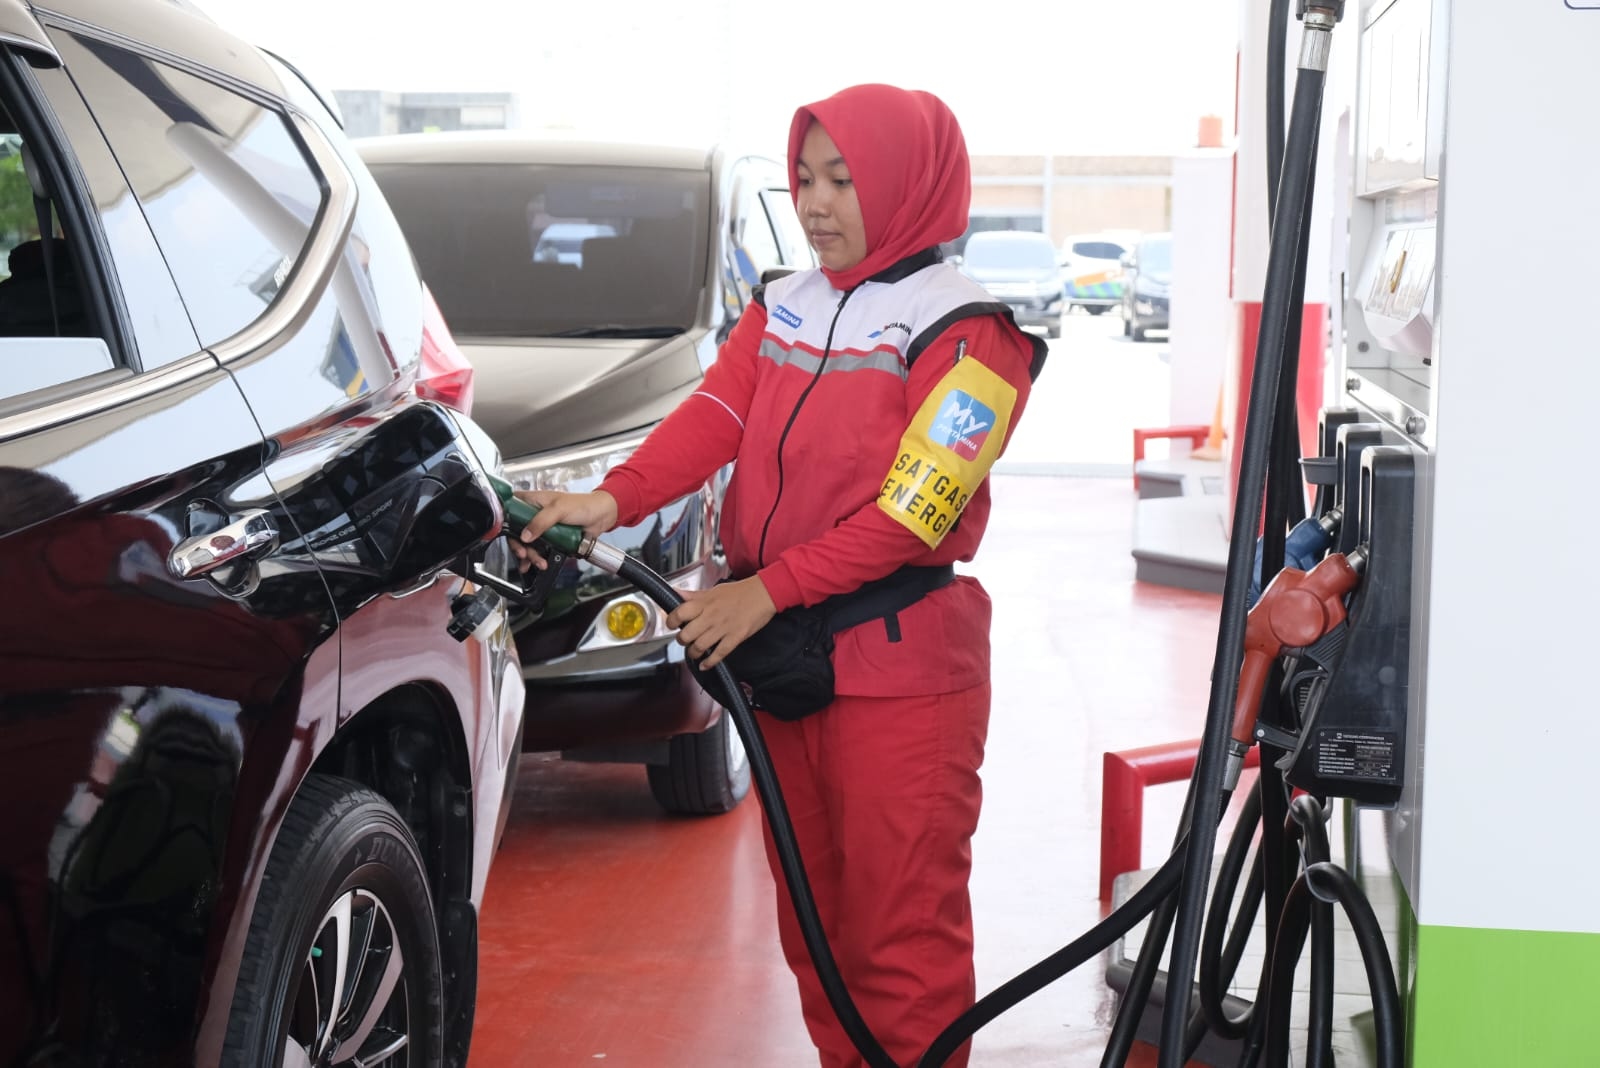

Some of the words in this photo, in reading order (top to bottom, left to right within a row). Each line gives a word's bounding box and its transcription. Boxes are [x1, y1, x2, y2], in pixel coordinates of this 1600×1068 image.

[936, 423, 978, 452] PERTAMINA
[943, 400, 988, 434] MY
[895, 453, 968, 512] SATGAS
[880, 478, 951, 537] ENERGI
